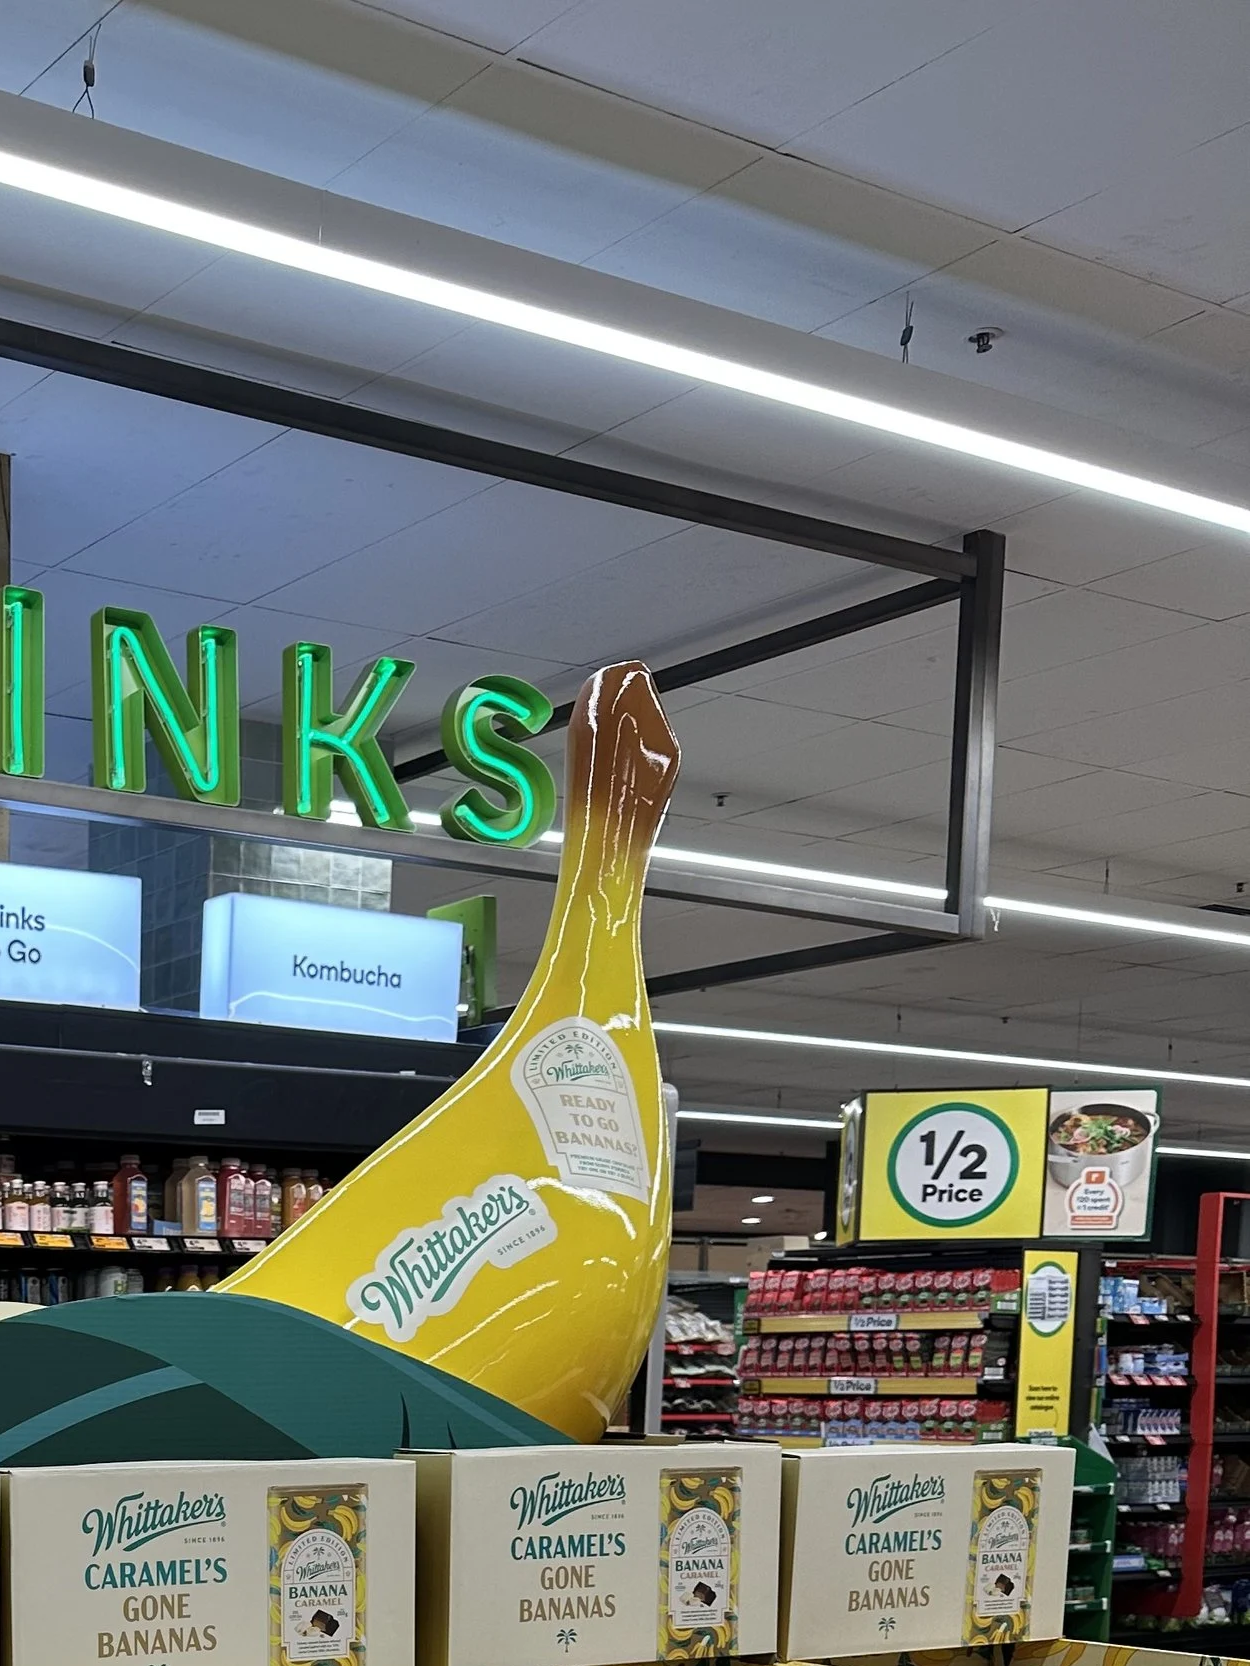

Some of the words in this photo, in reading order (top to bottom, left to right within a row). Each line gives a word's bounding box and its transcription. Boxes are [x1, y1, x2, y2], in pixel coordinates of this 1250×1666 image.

[8, 939, 41, 965] Go
[292, 955, 402, 989] Kombucha
[547, 1060, 609, 1082] Whittaker's
[559, 1094, 616, 1113] READY
[570, 1113, 593, 1127] TO
[598, 1117, 619, 1132] GO
[555, 1132, 637, 1157] BANANAS?
[922, 1183, 983, 1203] Price
[361, 1185, 529, 1329] Whittaker's
[497, 1237, 525, 1256] SINCE
[526, 1225, 545, 1240] 1896
[510, 1472, 626, 1530] Whittaker's
[847, 1474, 945, 1528] Whittaker's
[82, 1491, 226, 1557] Whittaker's
[511, 1533, 626, 1561] CARAMEL'S
[845, 1529, 942, 1555] CARAMEL'S
[675, 1559, 724, 1571] BANANA
[868, 1559, 915, 1582] GONE
[982, 1553, 1023, 1564] BANANA
[84, 1557, 228, 1590] CARAMEL'S
[540, 1565, 595, 1590] GONE
[288, 1584, 348, 1599] BANANA
[848, 1586, 930, 1612] BANANAS
[123, 1593, 191, 1623] GONE
[519, 1594, 616, 1623] BANANAS
[98, 1624, 218, 1658] BANANAS
